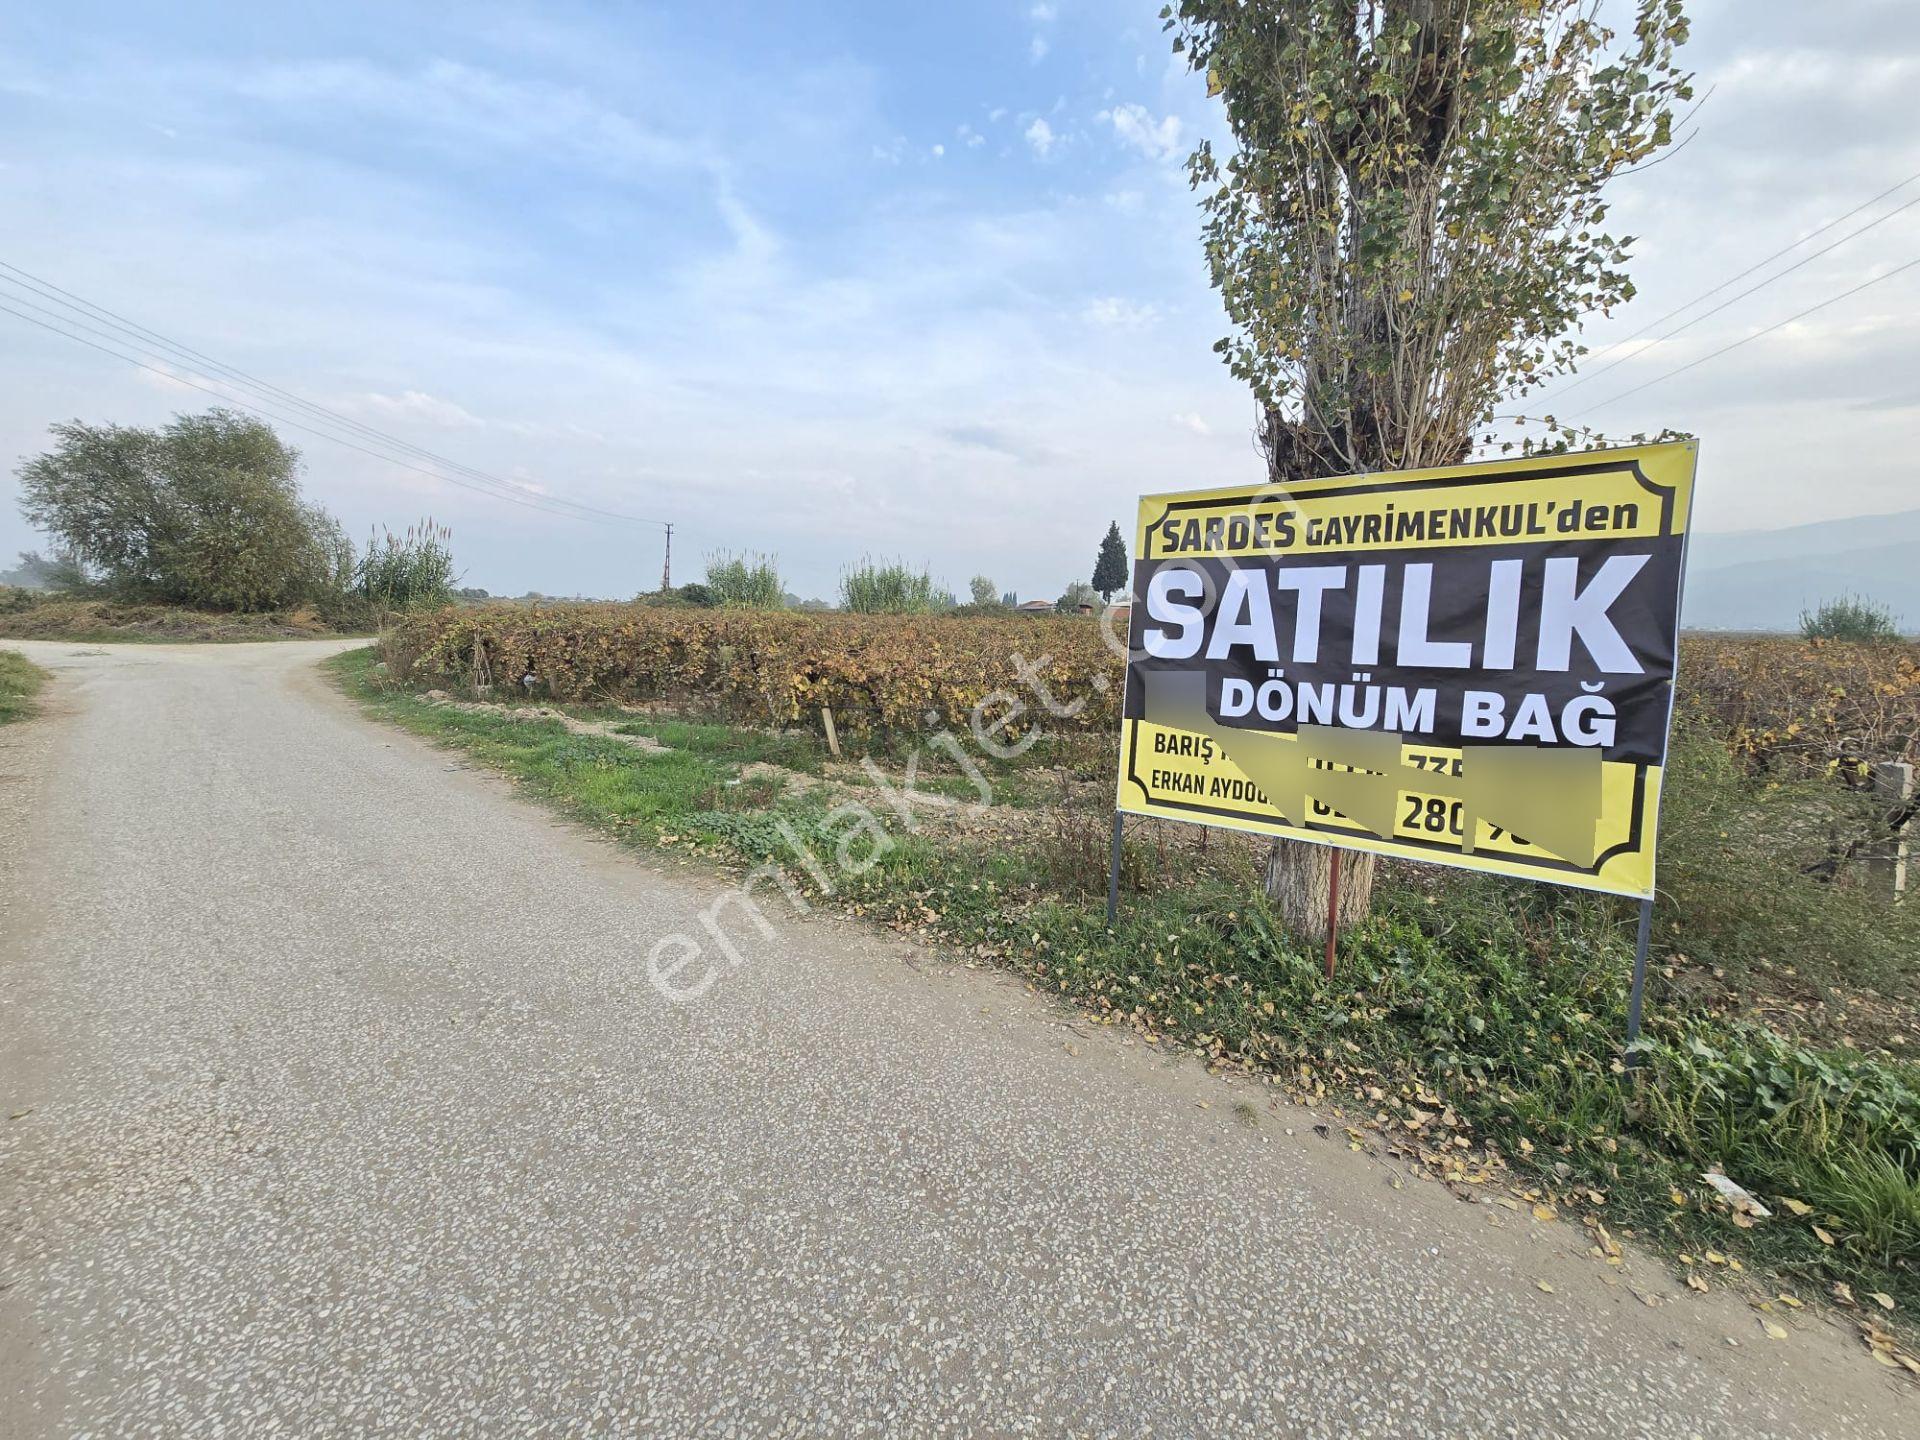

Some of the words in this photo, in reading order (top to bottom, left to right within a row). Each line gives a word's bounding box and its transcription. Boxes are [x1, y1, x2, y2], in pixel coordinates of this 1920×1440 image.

[1162, 511, 1296, 553] SARDES
[1143, 554, 1653, 673] SATILIK
[1219, 668, 1437, 735] DÖNÜM
[1461, 681, 1617, 747] BAĞ
[1154, 733, 1214, 765] BARIŞ
[1151, 769, 1205, 796] ERKAN
